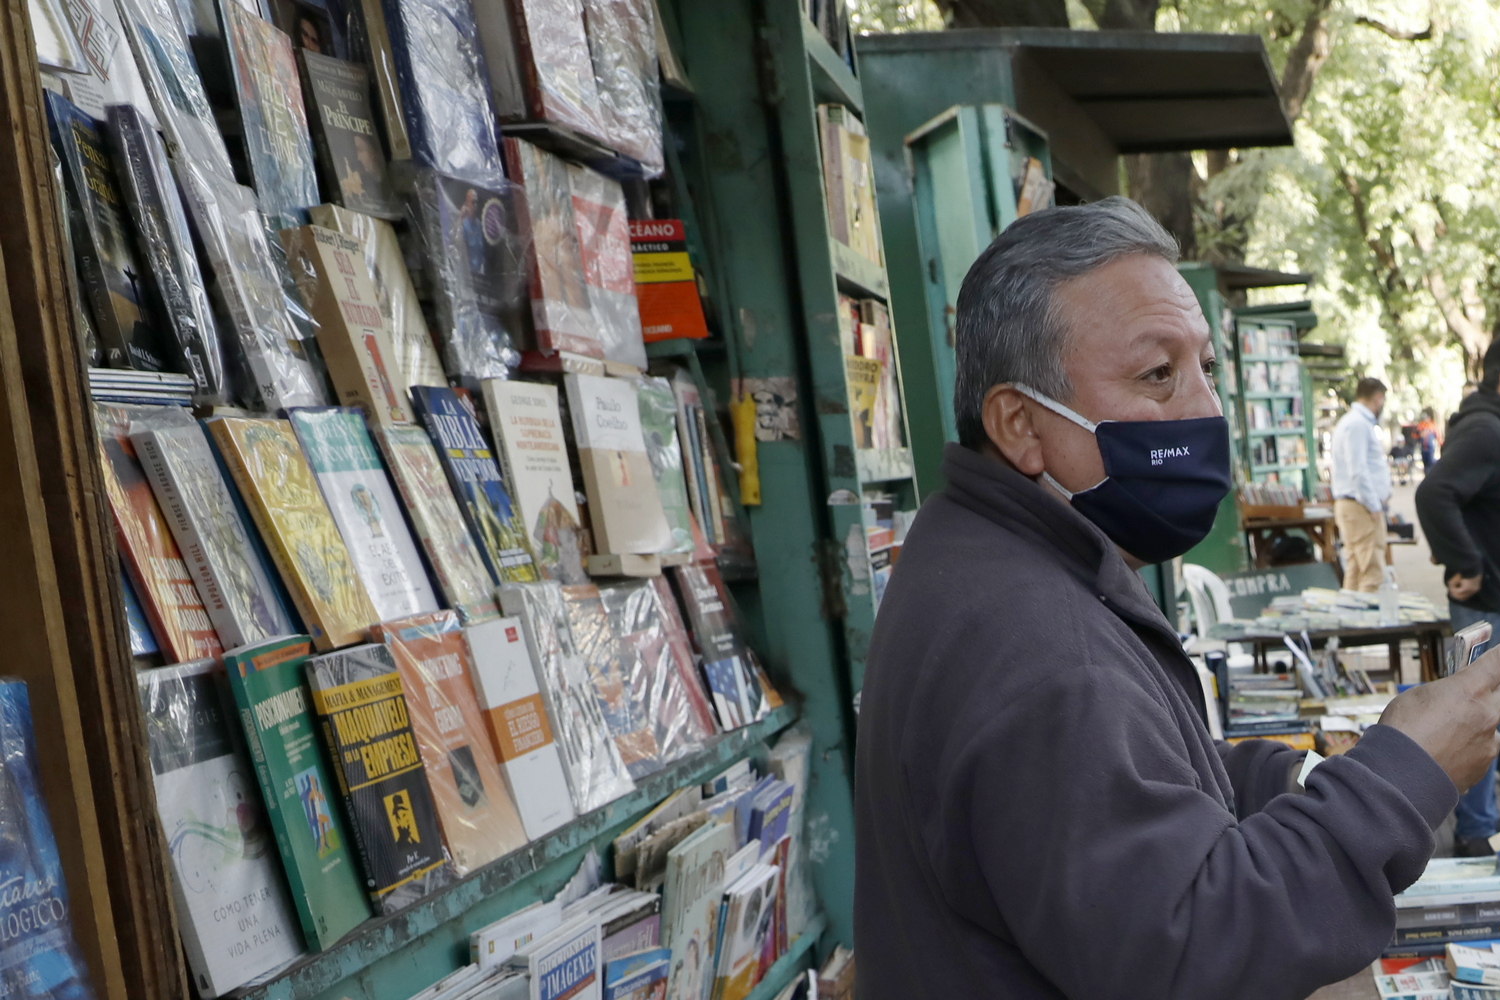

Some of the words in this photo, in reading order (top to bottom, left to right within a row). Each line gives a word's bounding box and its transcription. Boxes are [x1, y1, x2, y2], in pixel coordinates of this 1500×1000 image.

[629, 221, 675, 237] CÉANO
[441, 399, 458, 416] LA
[595, 396, 622, 414] Paulo
[433, 413, 489, 449] BIBLIA
[596, 414, 629, 430] Coelho
[1150, 446, 1190, 460] RE/MAX
[324, 693, 347, 711] MAFIA
[335, 695, 411, 747] MAQUIAVELO
[360, 732, 420, 781] EMPRESA
